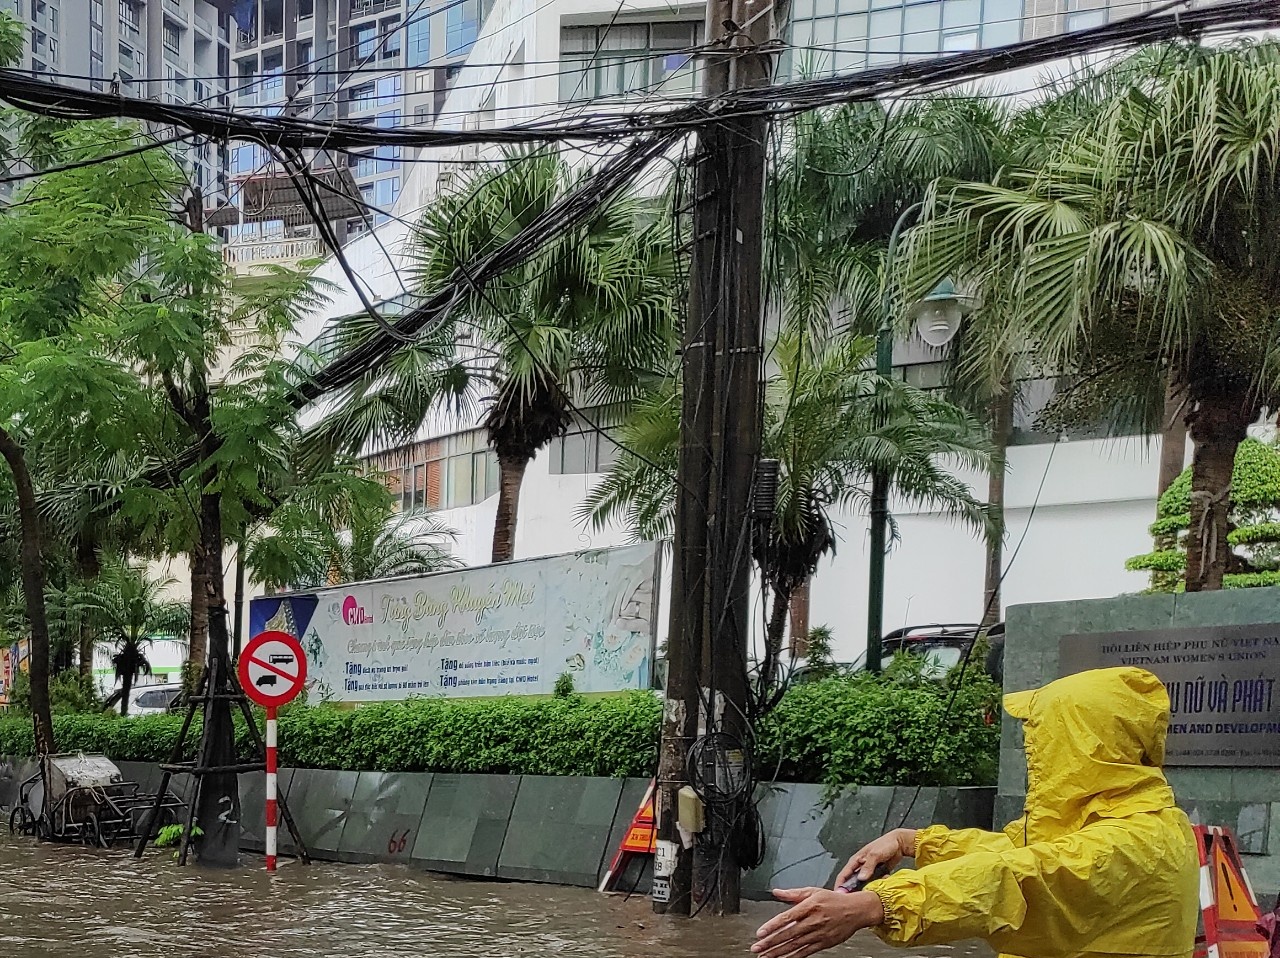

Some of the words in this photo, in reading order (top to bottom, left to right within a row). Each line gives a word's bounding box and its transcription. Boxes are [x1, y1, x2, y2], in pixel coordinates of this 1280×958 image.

[441, 657, 458, 673] Tặng
[1120, 654, 1170, 665] VIETNAM
[1228, 650, 1267, 662] UNION
[440, 673, 458, 690] Tặng
[1208, 673, 1229, 713] VÀ
[1231, 672, 1276, 712] PHÁT
[1189, 723, 1213, 734] AND
[217, 795, 238, 825] 2
[388, 829, 410, 854] 66
